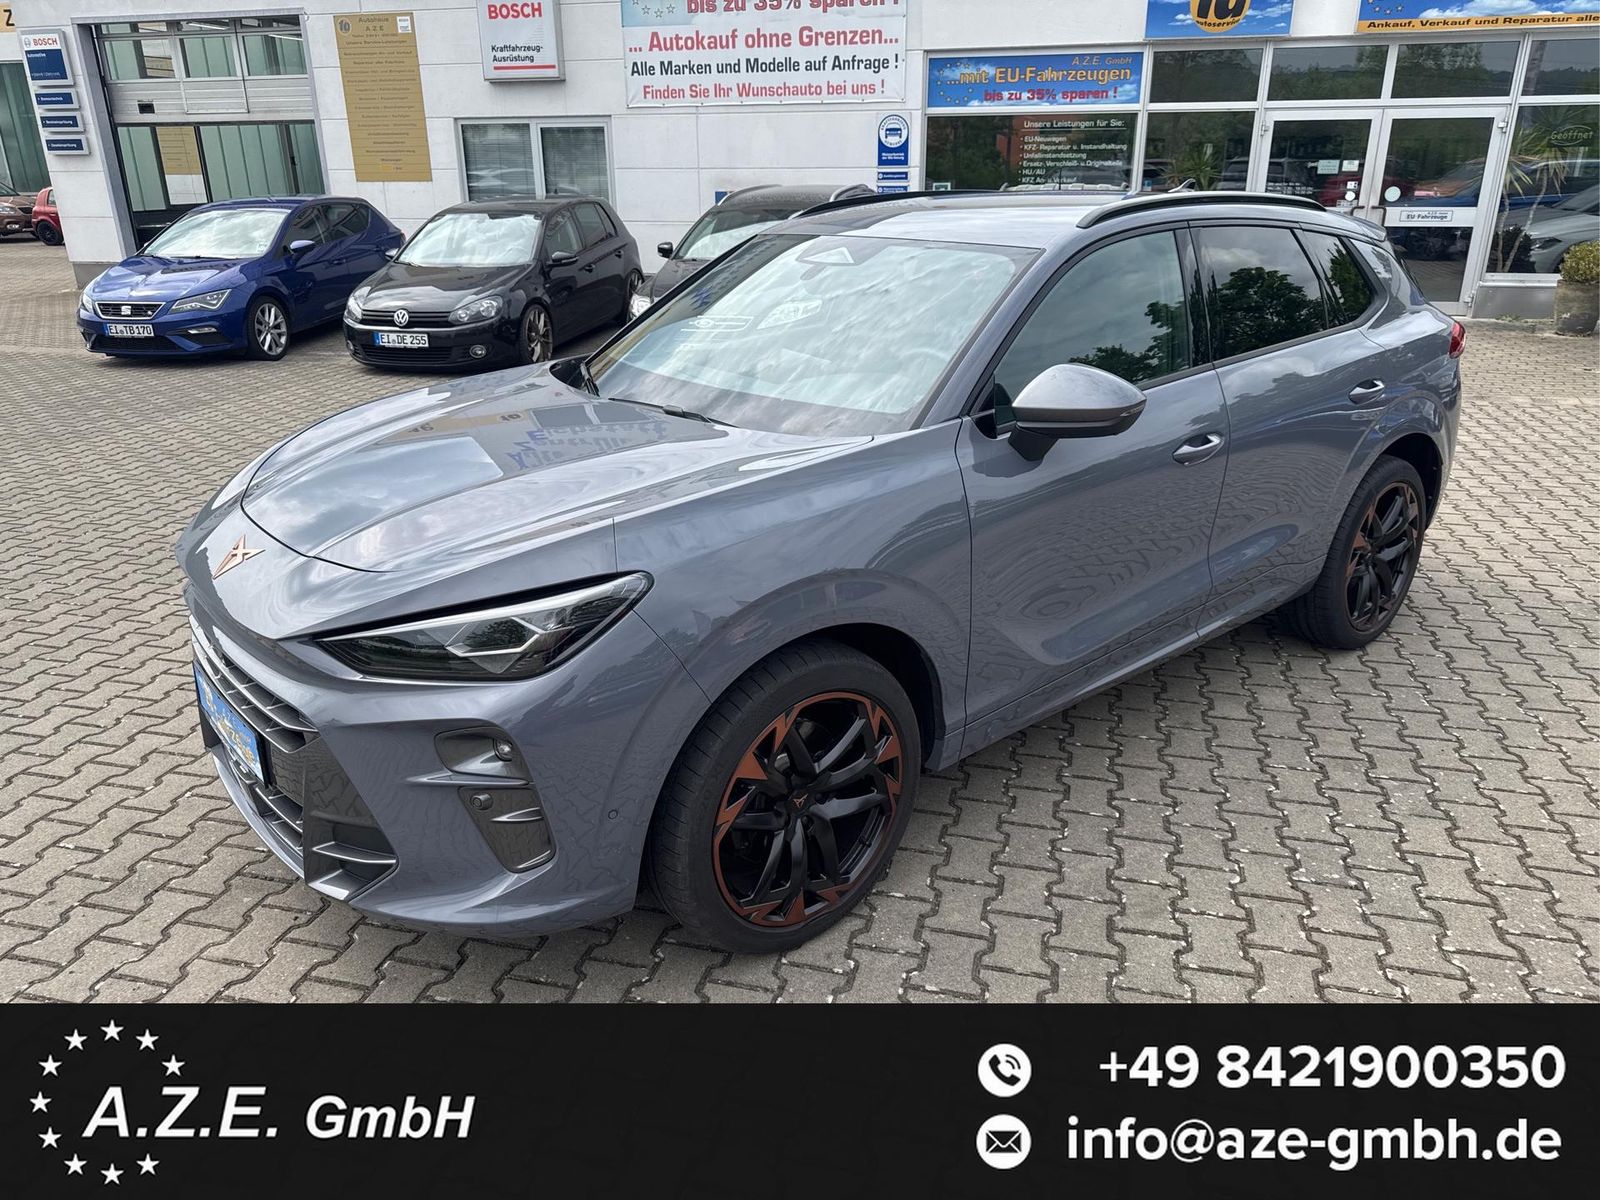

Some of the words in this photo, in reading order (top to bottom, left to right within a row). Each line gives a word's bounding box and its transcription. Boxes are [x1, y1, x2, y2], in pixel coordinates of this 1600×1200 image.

[487, 2, 543, 20] BOSCH
[723, 0, 746, 12] zu
[1367, 21, 1415, 29] Ankauf,
[1420, 18, 1471, 27] Verkauf
[1475, 17, 1498, 25] und
[1503, 16, 1572, 25] Reparatur
[33, 37, 58, 47] BOSCH
[648, 28, 738, 52] Autokauf
[744, 27, 792, 49] ohne
[798, 25, 899, 47] Grenzen...
[491, 44, 544, 53] Kraftfahrzeug-
[492, 54, 535, 63] Ausrüstung
[1104, 56, 1133, 65] GmbH
[631, 61, 656, 76] Alle
[660, 60, 712, 76] Marken
[716, 58, 741, 74] und
[745, 57, 800, 73] Modelle
[804, 55, 827, 71] auf
[831, 54, 890, 74] Anfrage
[994, 66, 1131, 84] EU-Fahrzeugen
[643, 84, 685, 99] Finden
[689, 83, 710, 98] Sie
[714, 82, 732, 98] Ihr
[736, 81, 822, 98] Wunschauto
[826, 80, 847, 95] bei
[851, 82, 876, 95] uns
[984, 89, 1003, 101] bis
[1007, 91, 1022, 101] zu
[1026, 89, 1057, 101] 35%
[1061, 89, 1108, 103] sparen
[1023, 120, 1051, 128] Unsere
[1053, 120, 1094, 129] Leistungen
[1096, 119, 1107, 127] für
[1110, 119, 1125, 127] Sie:
[1551, 130, 1593, 140] Geöffnet
[1080, 143, 1128, 151] Instandhaltung
[1417, 213, 1448, 221] Fahrzeuge
[108, 325, 119, 335] EI
[380, 334, 391, 344] EI
[397, 335, 408, 345] DE
[410, 335, 427, 346] 255
